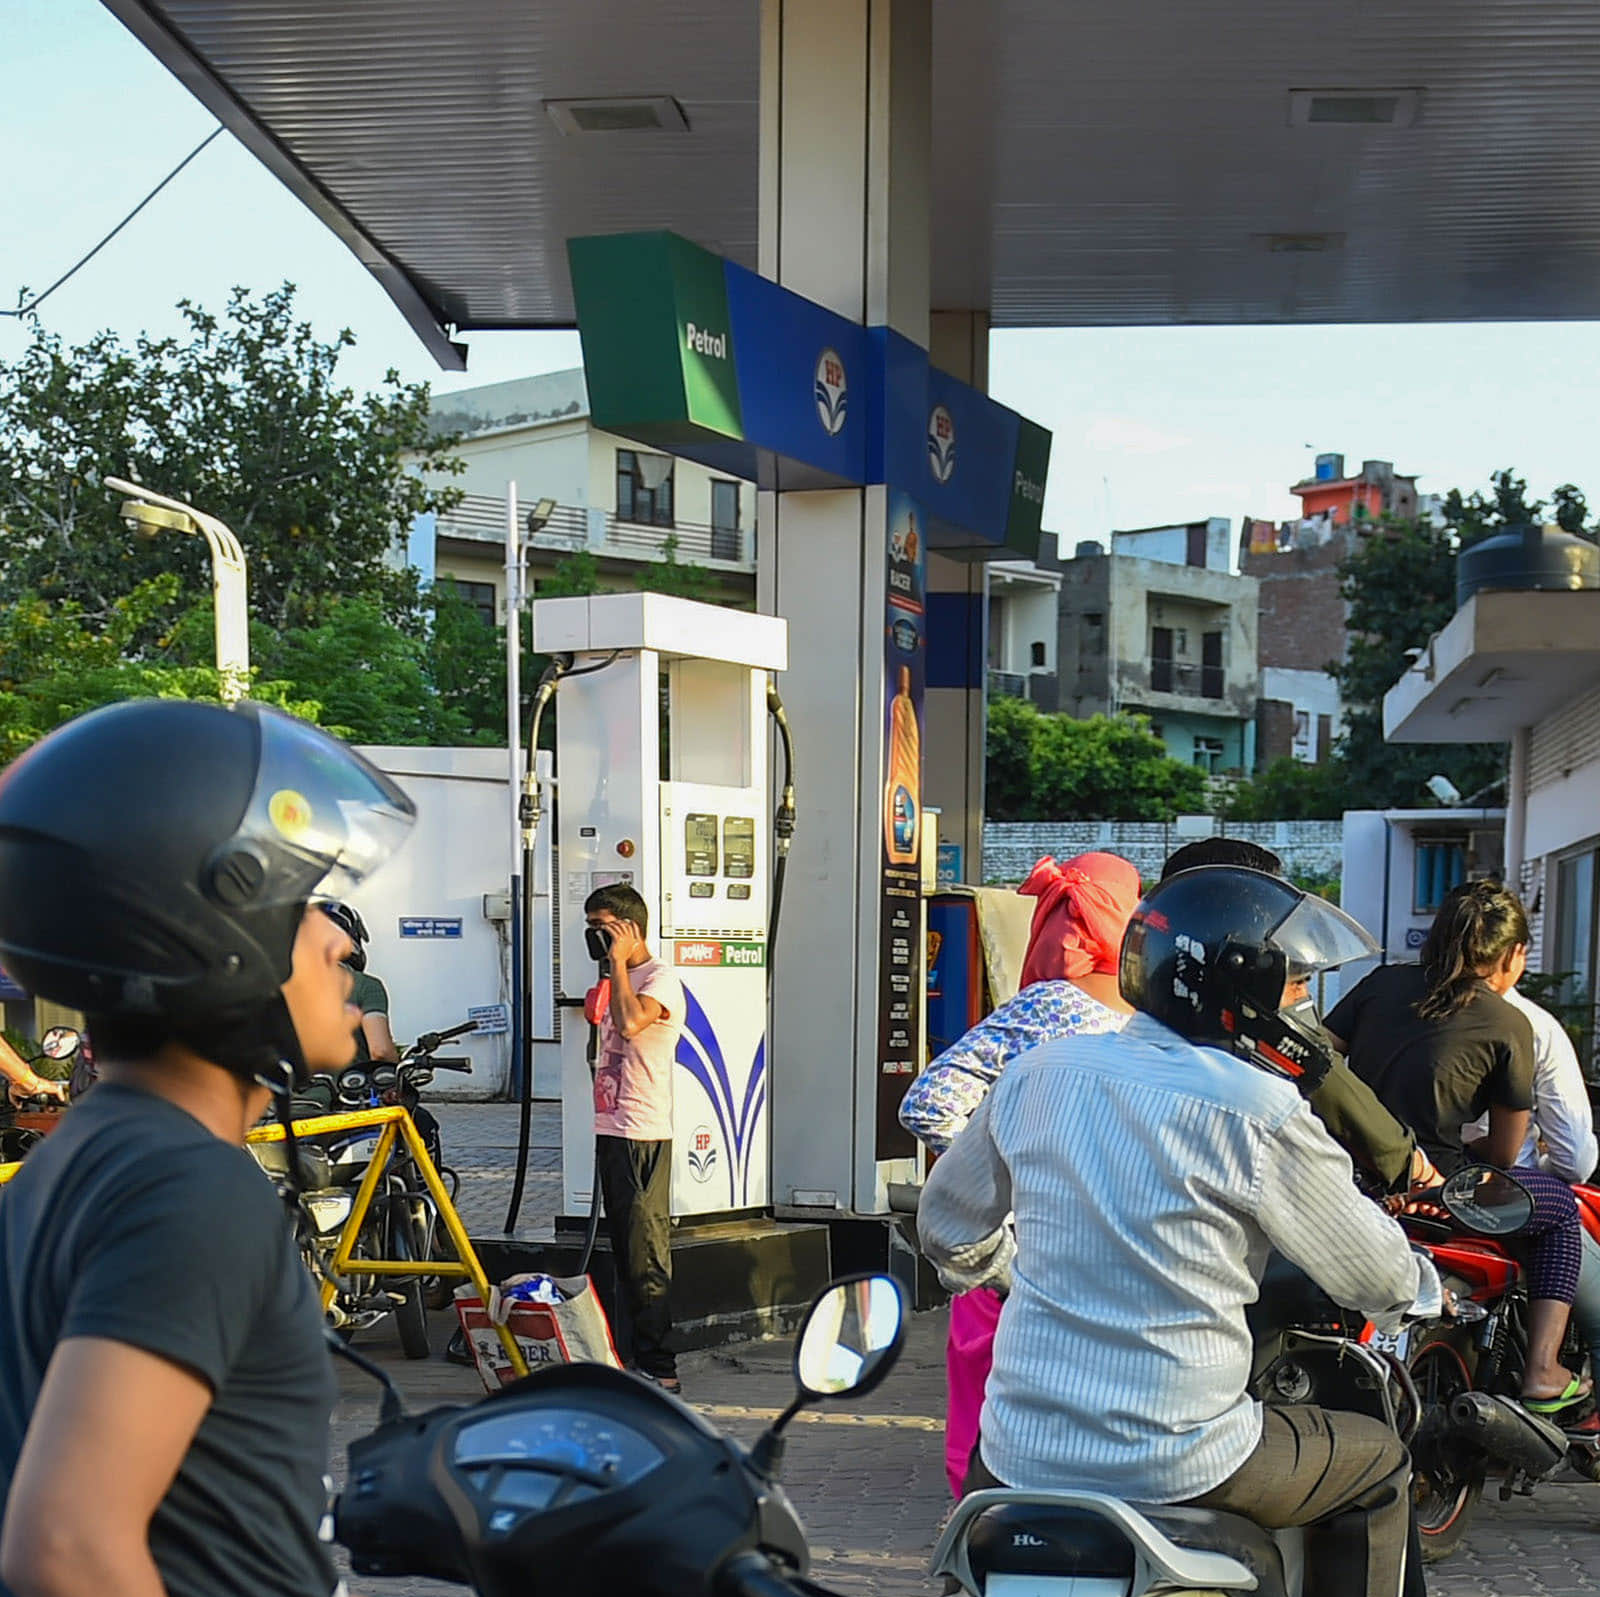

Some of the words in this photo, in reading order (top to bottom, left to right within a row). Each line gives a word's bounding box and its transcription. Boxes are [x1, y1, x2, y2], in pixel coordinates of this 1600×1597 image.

[686, 323, 726, 360] Petrol
[825, 361, 841, 387] HP
[936, 413, 951, 439] HP
[726, 945, 762, 964] Petrol
[695, 1133, 711, 1151] HP
